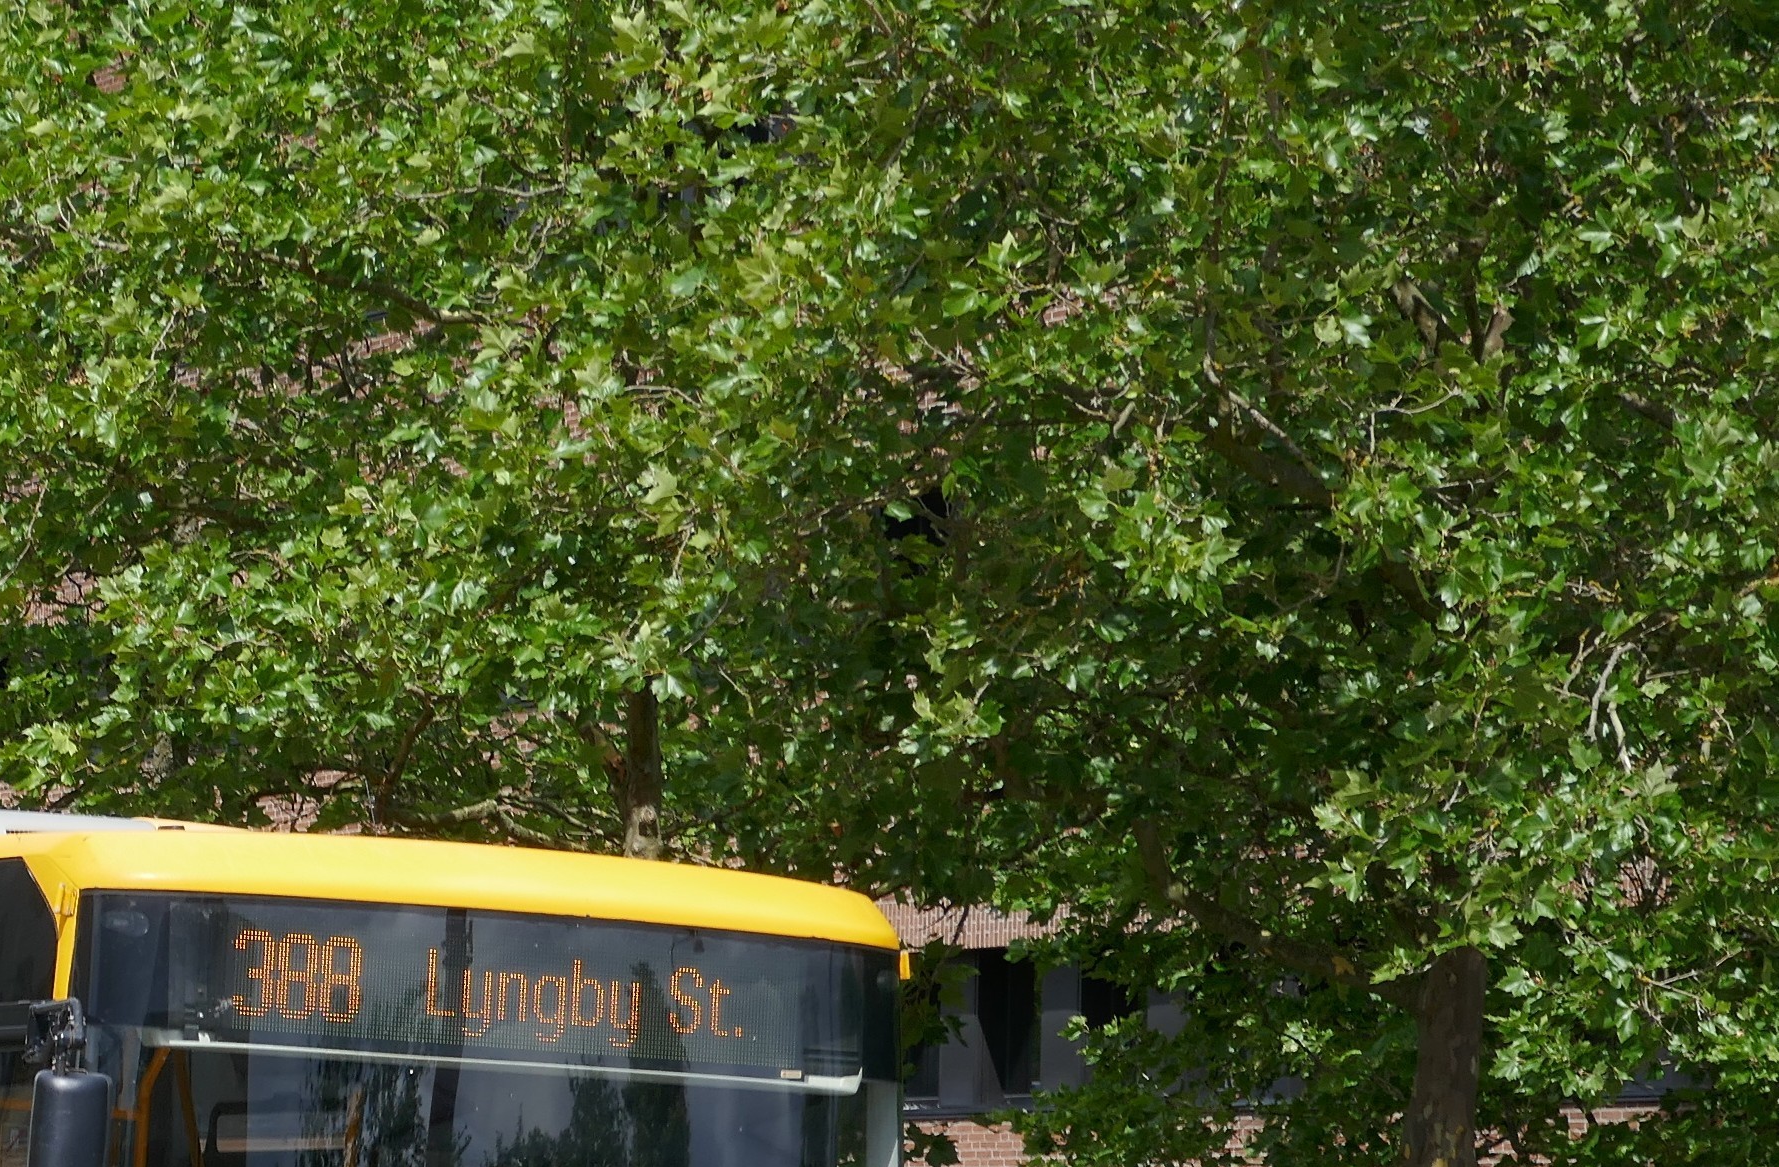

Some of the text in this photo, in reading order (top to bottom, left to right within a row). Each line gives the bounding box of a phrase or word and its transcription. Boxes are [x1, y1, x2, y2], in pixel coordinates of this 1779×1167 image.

[232, 927, 744, 1049] 388 Lyngby St.
